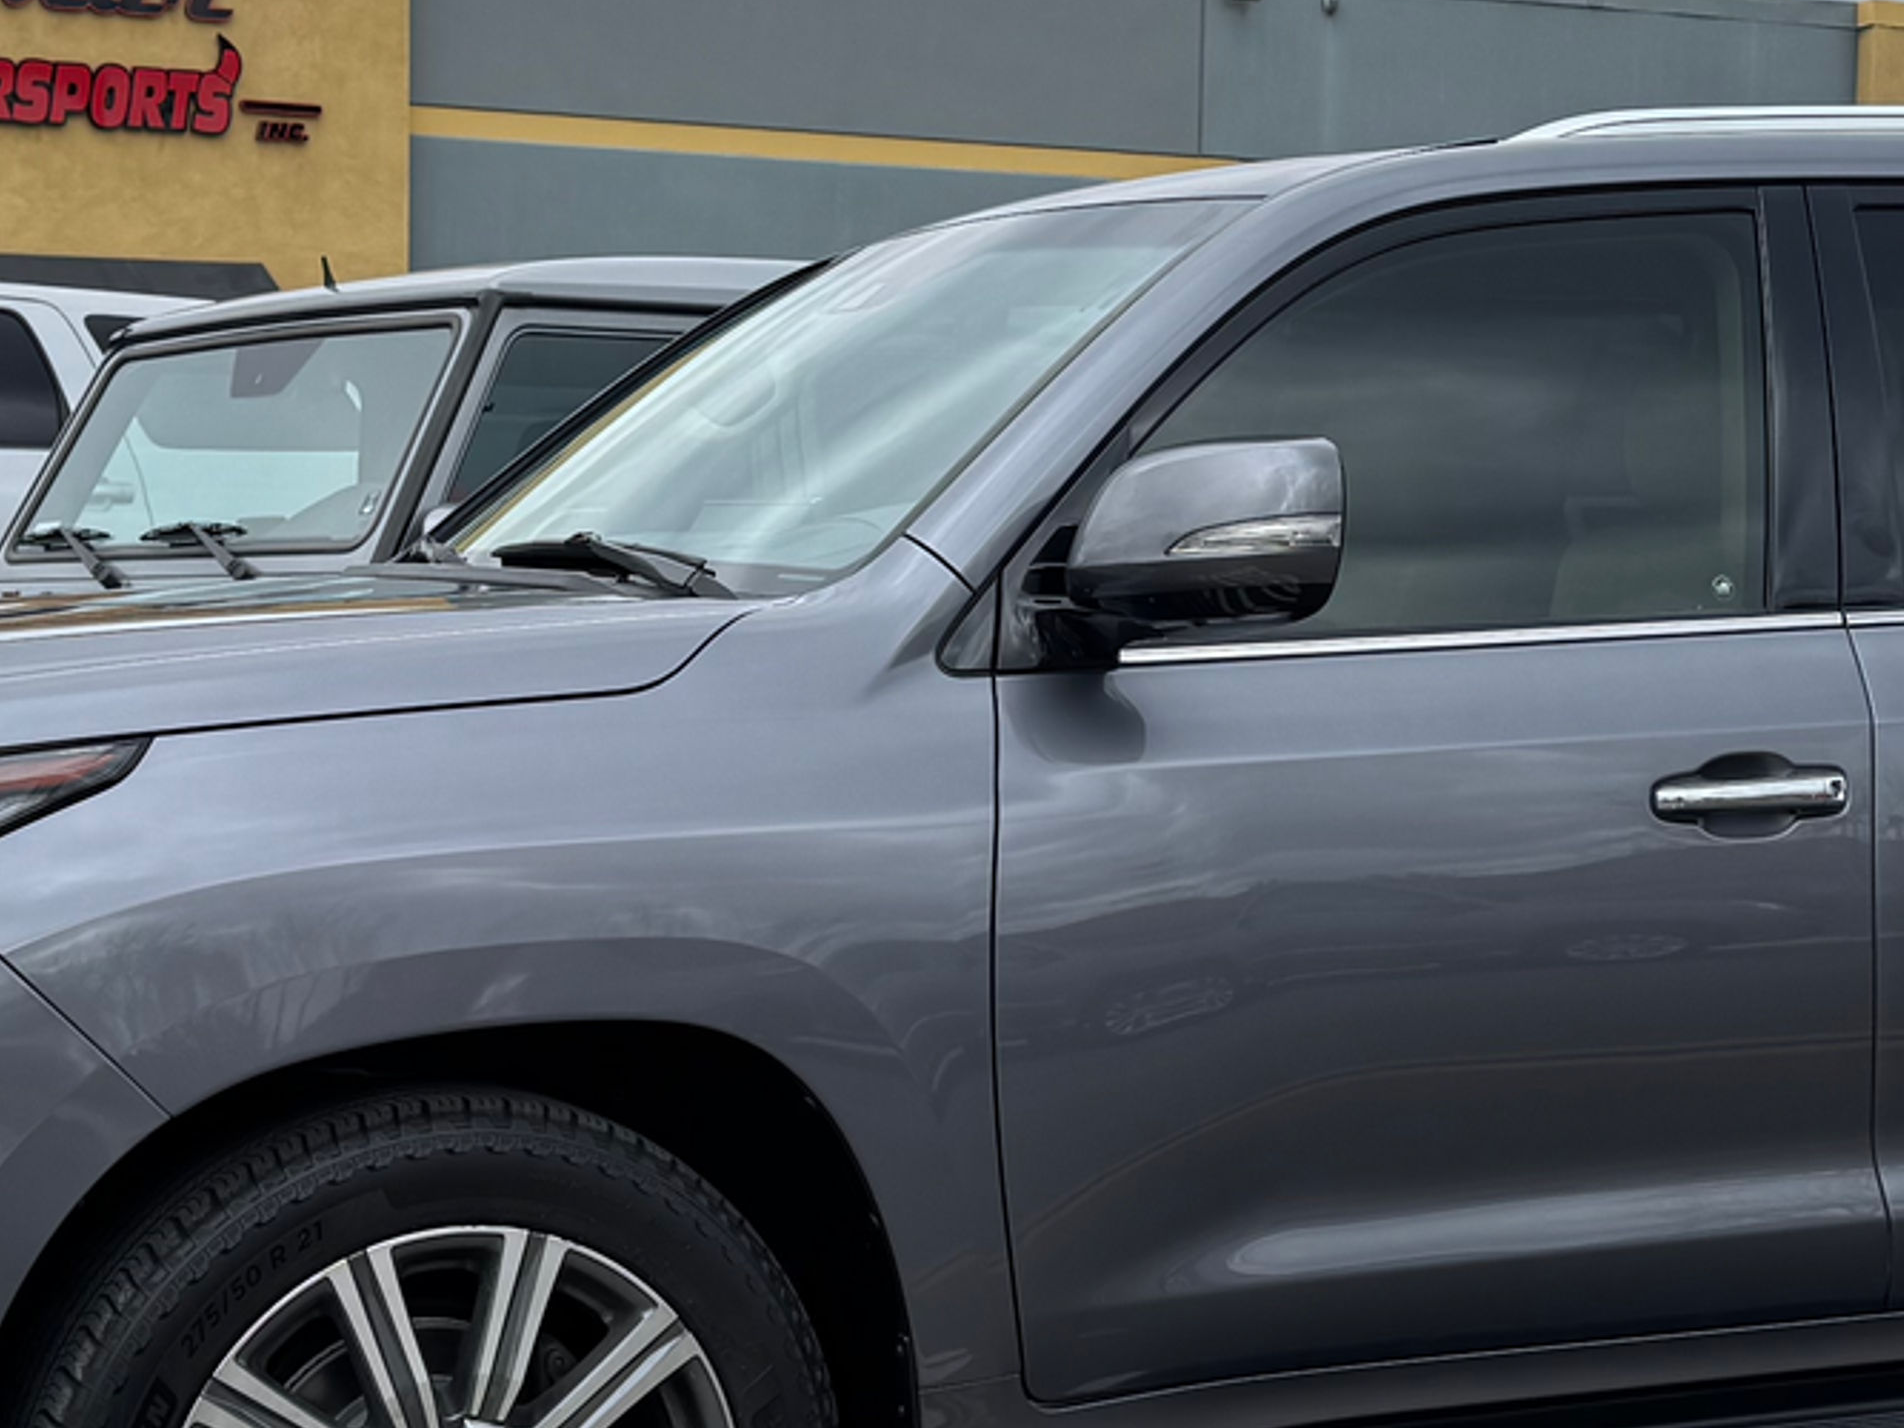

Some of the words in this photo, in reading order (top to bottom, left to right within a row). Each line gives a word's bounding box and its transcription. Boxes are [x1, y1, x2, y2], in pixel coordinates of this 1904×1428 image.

[256, 121, 309, 143] INC.
[181, 1260, 262, 1359] 275/50
[269, 1242, 289, 1272] R
[297, 1218, 324, 1249] 21
